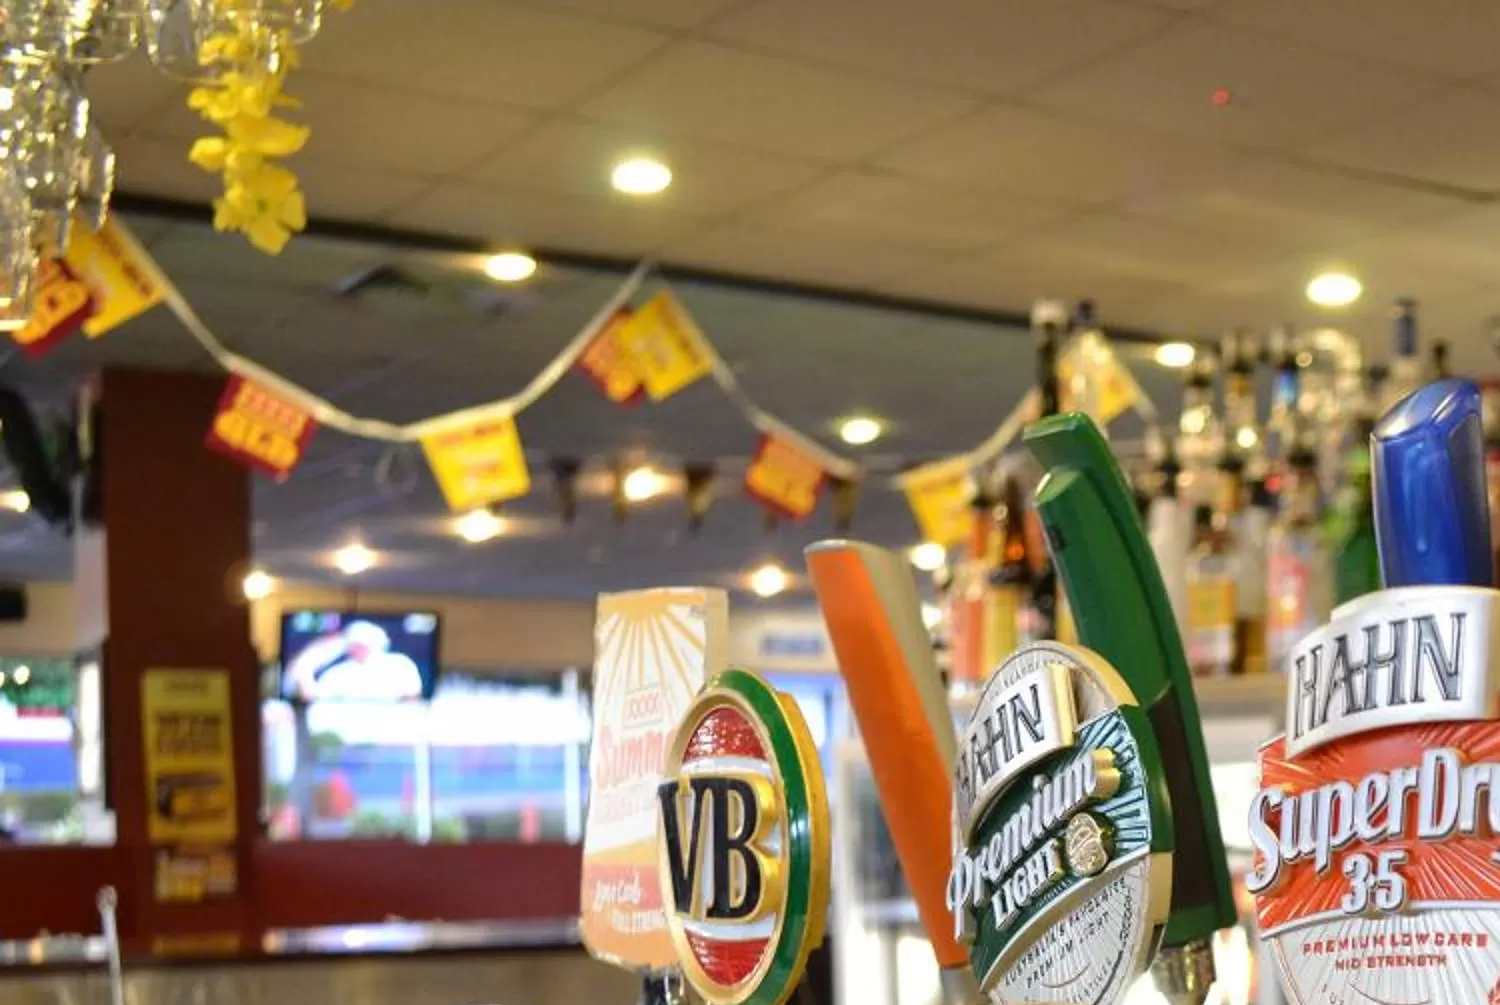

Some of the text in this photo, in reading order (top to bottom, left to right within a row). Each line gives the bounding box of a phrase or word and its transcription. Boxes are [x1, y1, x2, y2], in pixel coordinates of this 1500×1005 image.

[1292, 611, 1467, 741] HAHN
[658, 776, 763, 918] VB
[946, 750, 1099, 943] Premium
[991, 837, 1060, 931] LIGHT
[1302, 934, 1385, 957] PREMIUM
[1389, 931, 1431, 948] LOW
[1335, 953, 1448, 971] MID STRENGTH
